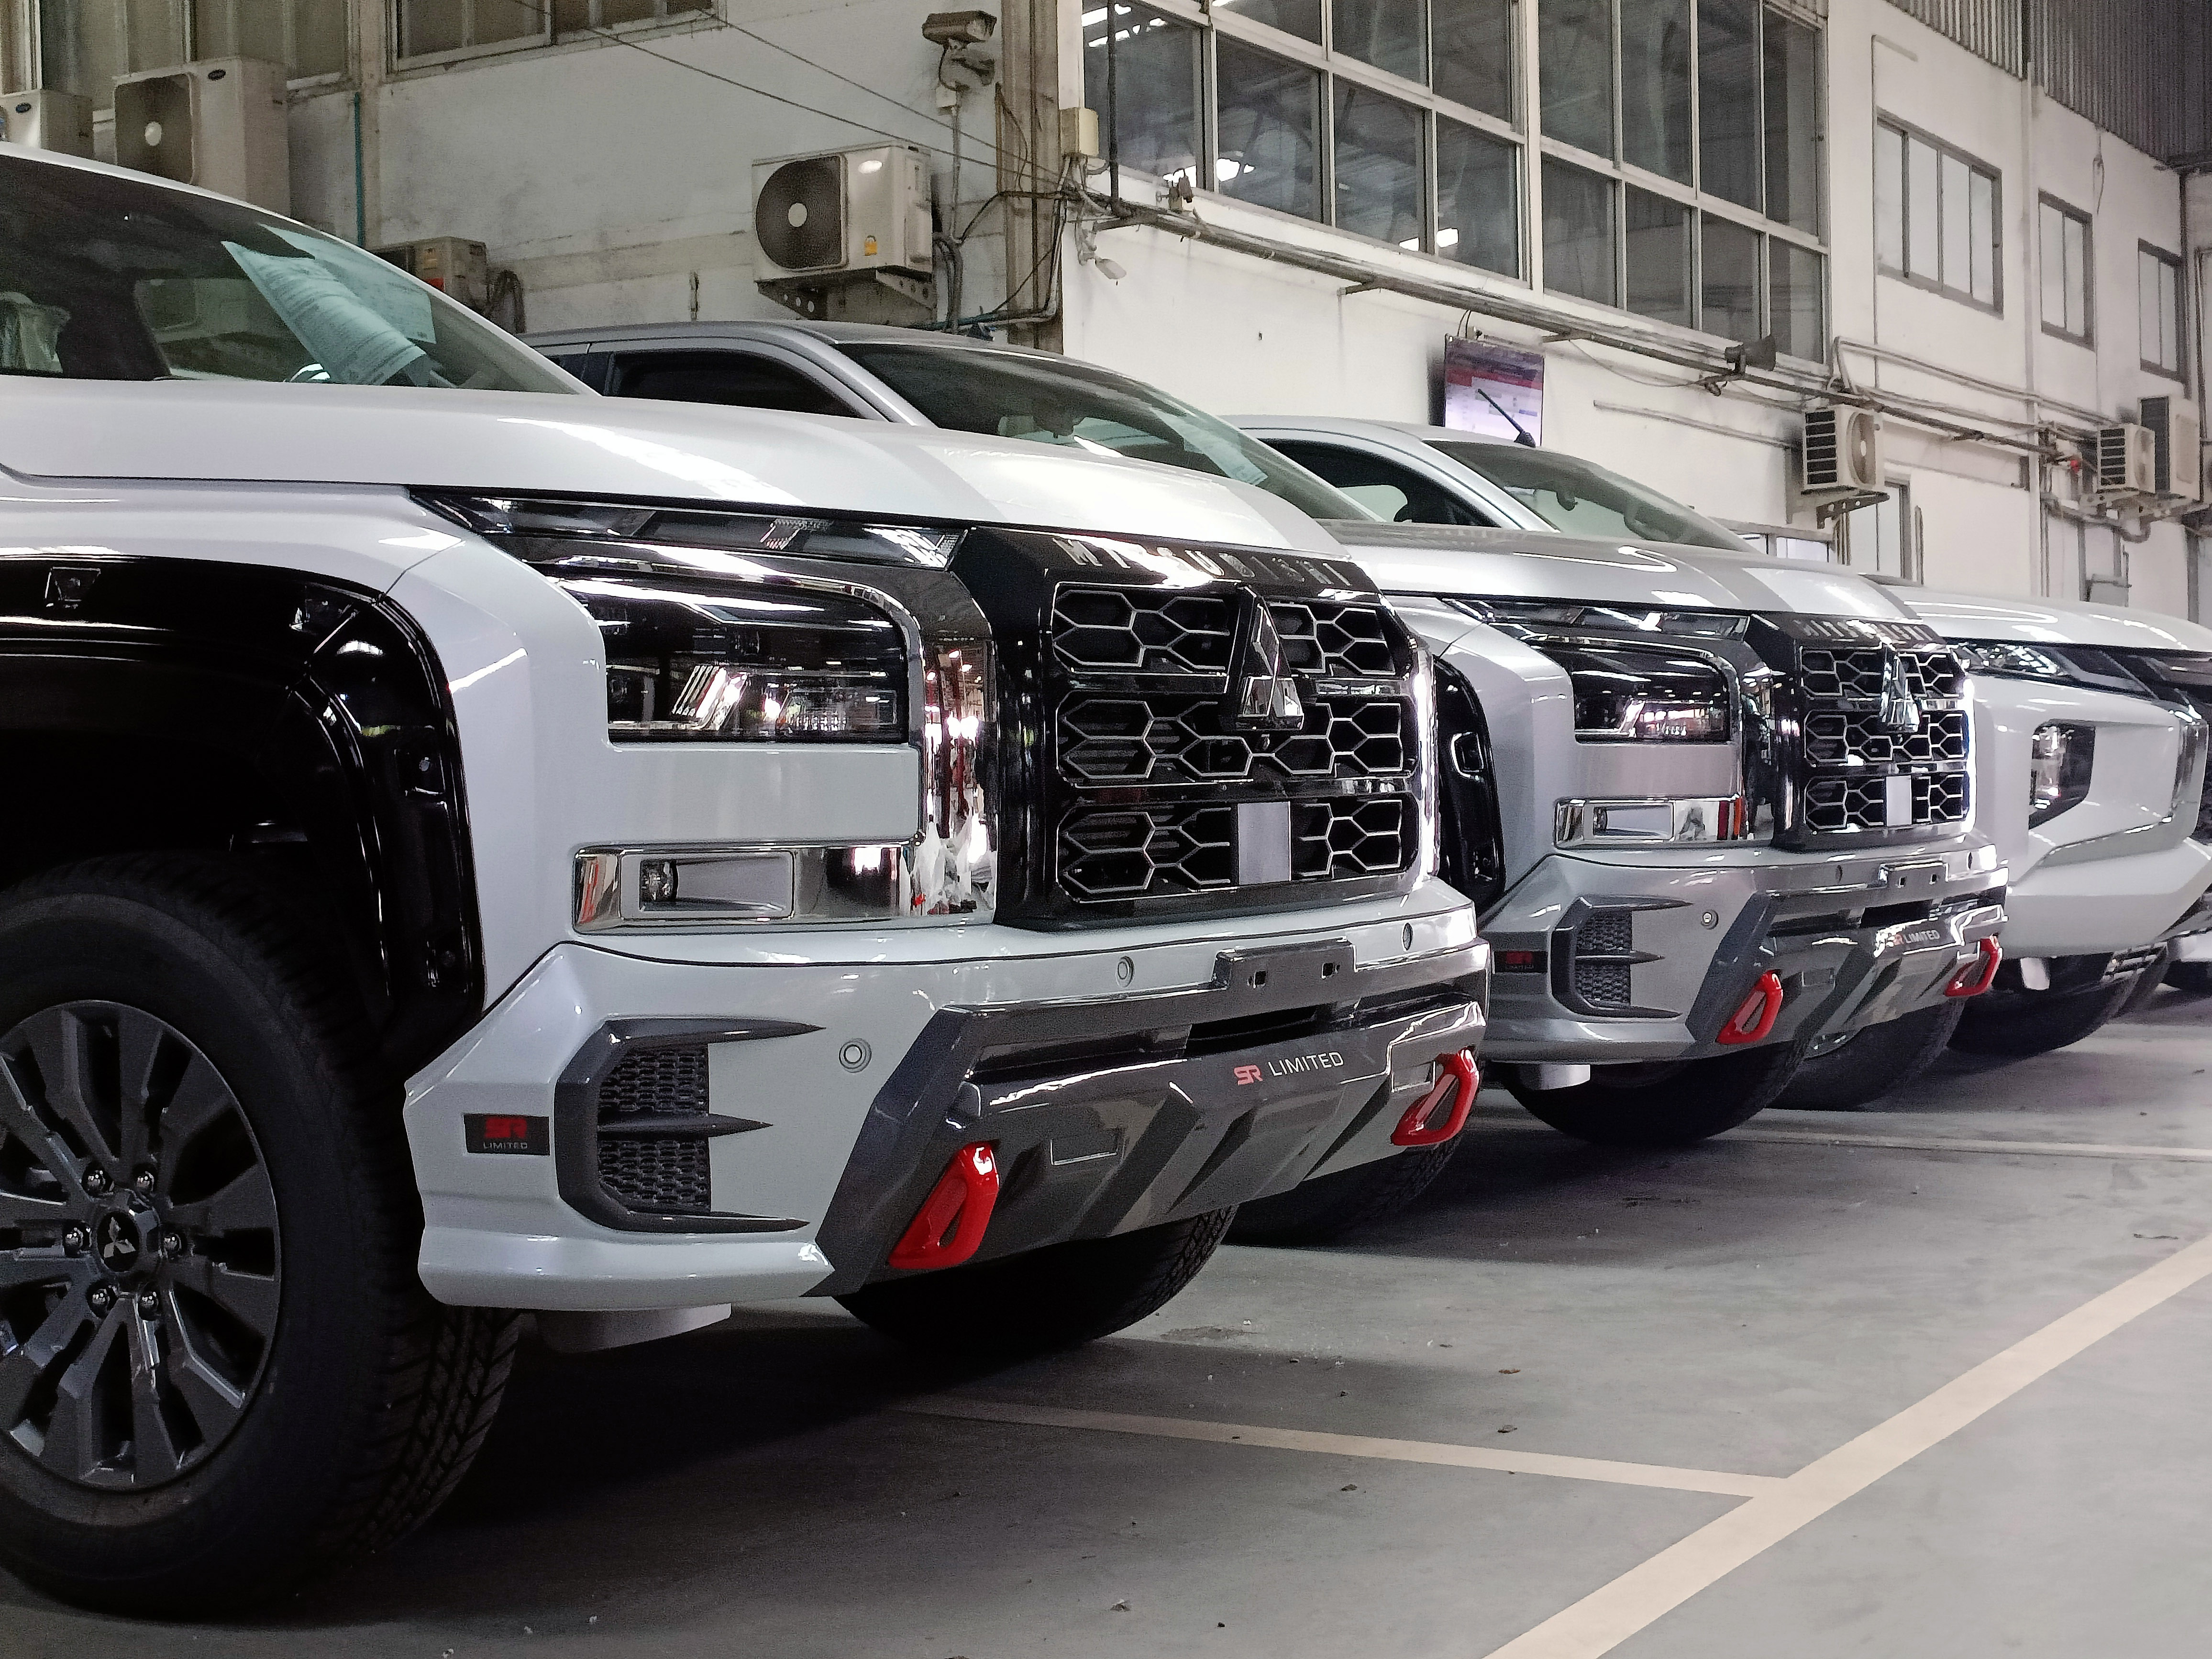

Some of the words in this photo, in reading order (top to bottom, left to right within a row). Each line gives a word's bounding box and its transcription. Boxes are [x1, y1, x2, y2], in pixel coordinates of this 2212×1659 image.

[1052, 538, 1351, 586] MISUBISHI
[1903, 929, 1940, 943] LIMITED
[1234, 1064, 1263, 1085] SR
[1268, 1052, 1344, 1076] LIMITED
[483, 1141, 528, 1150] LIMITED
